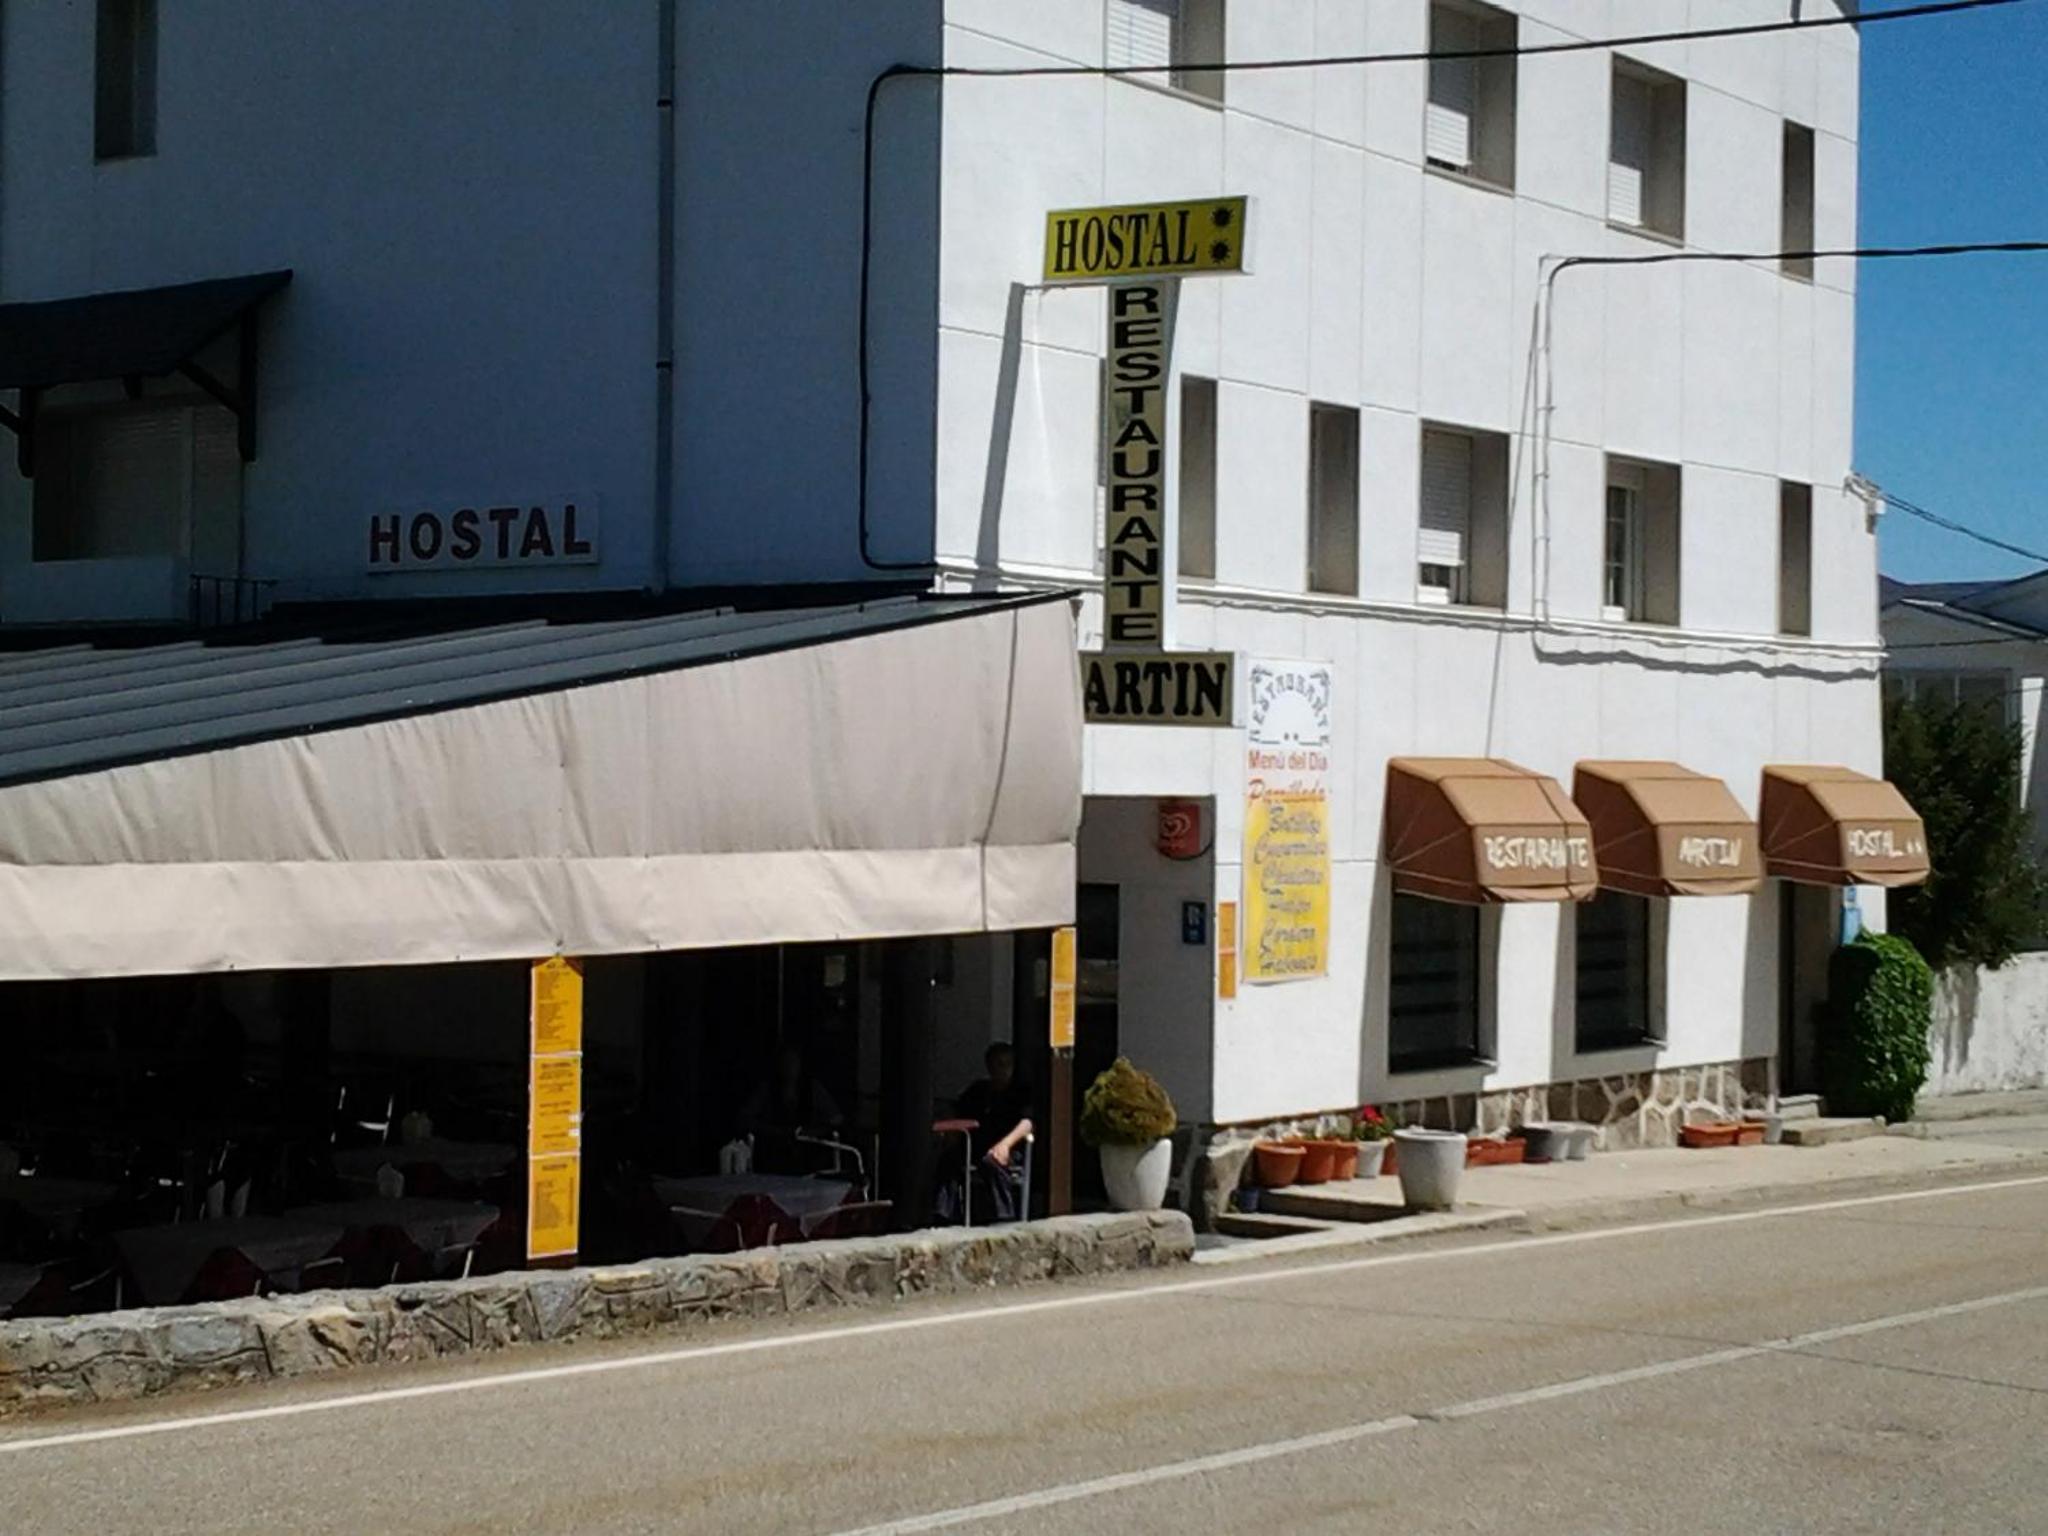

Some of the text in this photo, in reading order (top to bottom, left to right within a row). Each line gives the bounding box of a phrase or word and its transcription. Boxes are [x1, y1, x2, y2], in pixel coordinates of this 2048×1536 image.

[1053, 209, 1197, 273] HOSTAL
[1111, 286, 1161, 641] RESTAURANTE
[369, 504, 592, 564] HOSTAL
